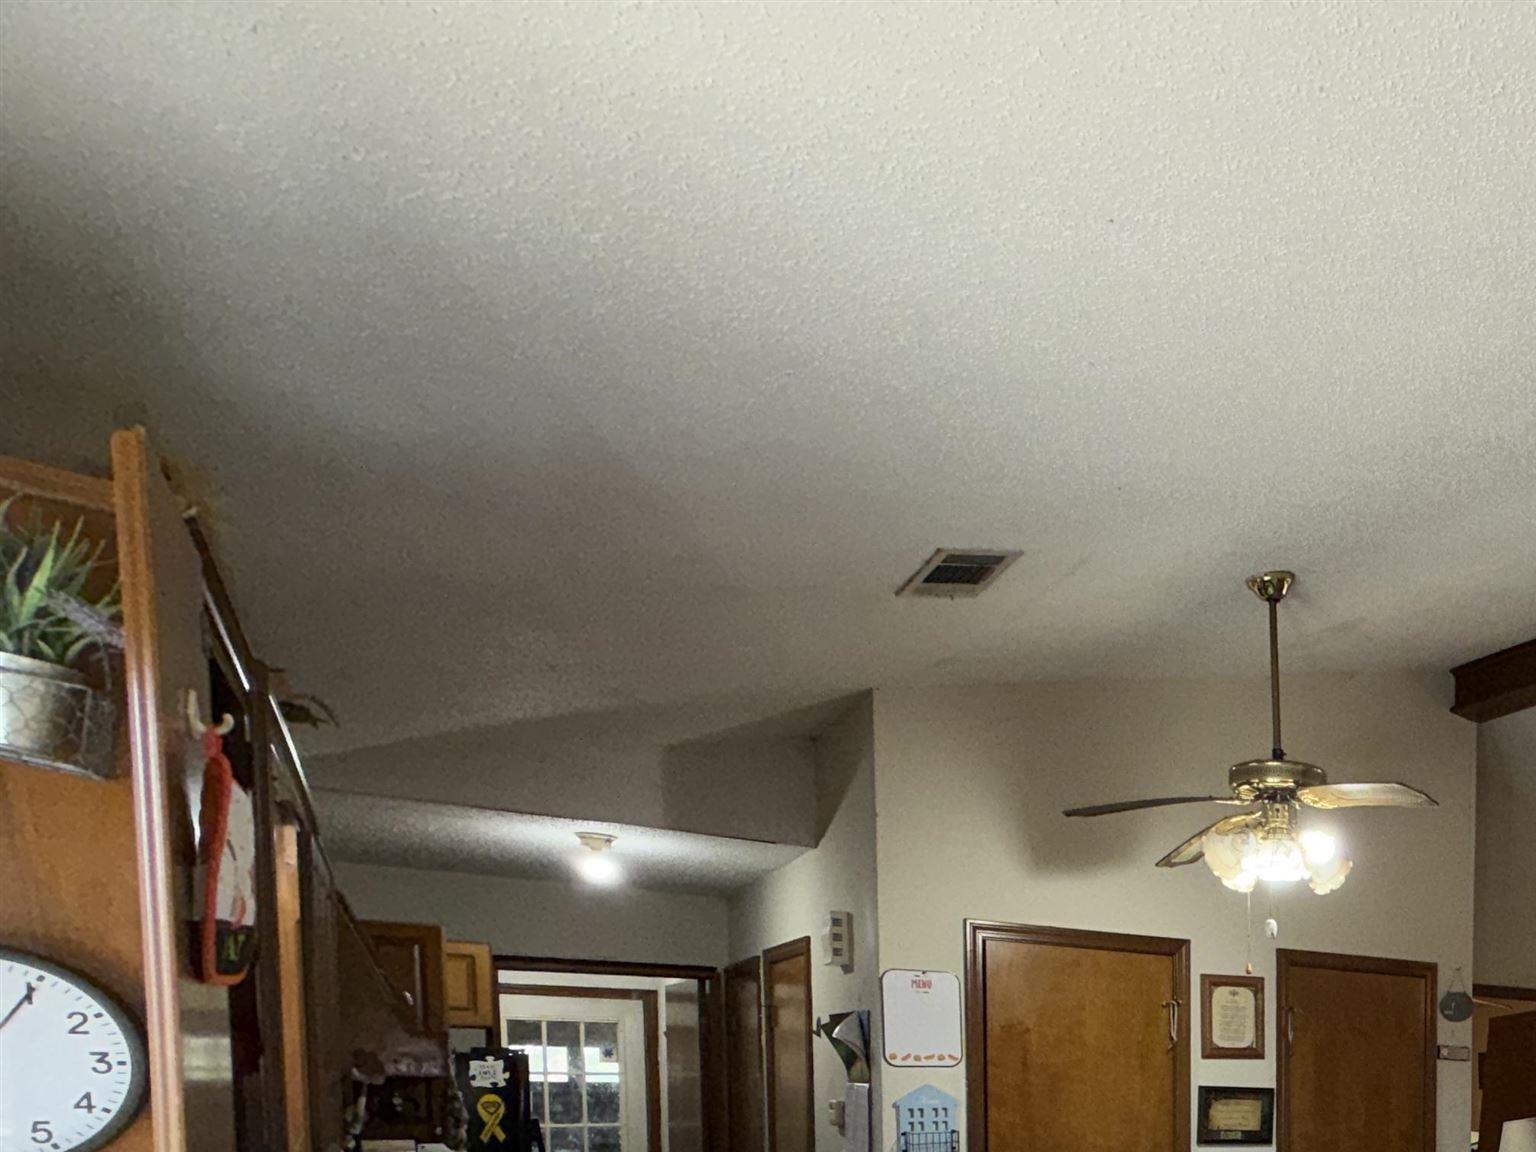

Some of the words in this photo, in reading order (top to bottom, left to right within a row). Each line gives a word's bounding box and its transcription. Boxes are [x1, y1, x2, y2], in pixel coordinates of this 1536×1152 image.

[67, 1012, 90, 1035] 2
[88, 1051, 113, 1075] 3
[73, 1091, 96, 1114] 4
[30, 1120, 54, 1144] 5
